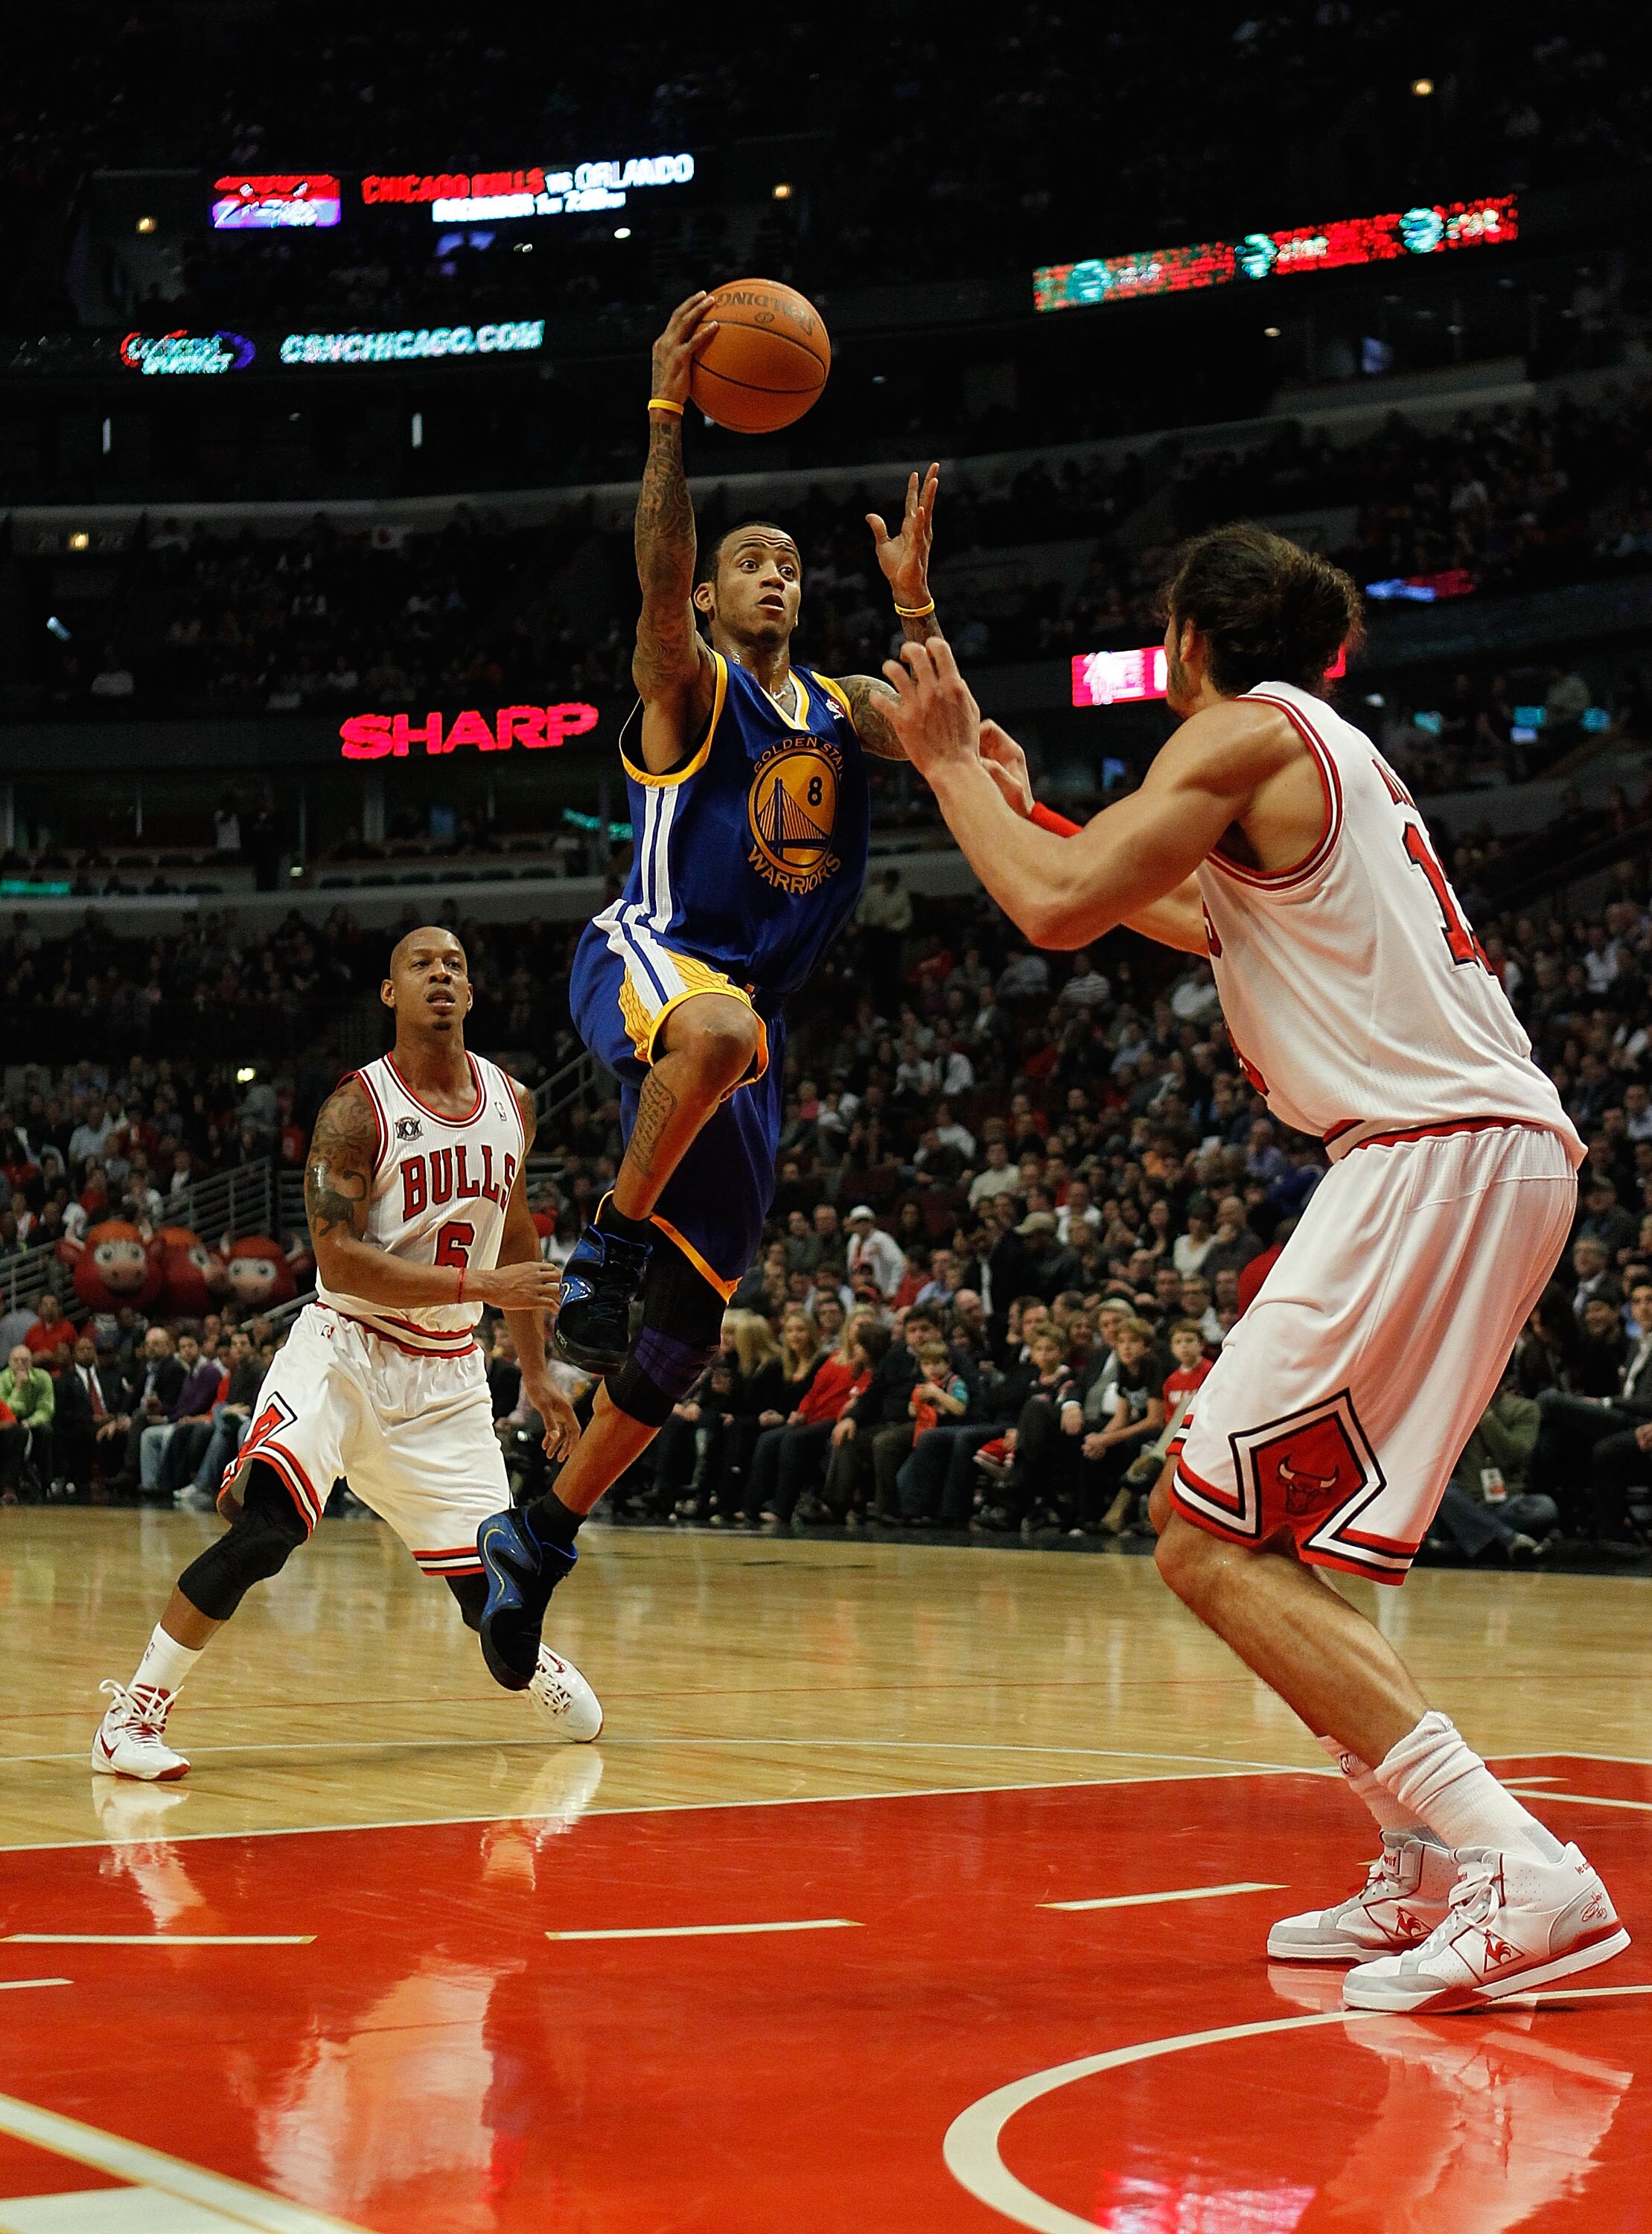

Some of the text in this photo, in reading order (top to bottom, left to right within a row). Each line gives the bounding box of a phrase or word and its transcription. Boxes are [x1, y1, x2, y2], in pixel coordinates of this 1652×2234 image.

[362, 174, 470, 204] CHICAGO
[574, 153, 694, 189] ORLANDO
[281, 319, 545, 363] CSNCHICAGO.COM
[339, 702, 599, 760] SHARP
[754, 736, 817, 774] GOLDEN
[807, 775, 823, 806] 8
[747, 844, 842, 894] WARRIORS
[1402, 821, 1493, 976] 1
[400, 1145, 516, 1223] BULLS
